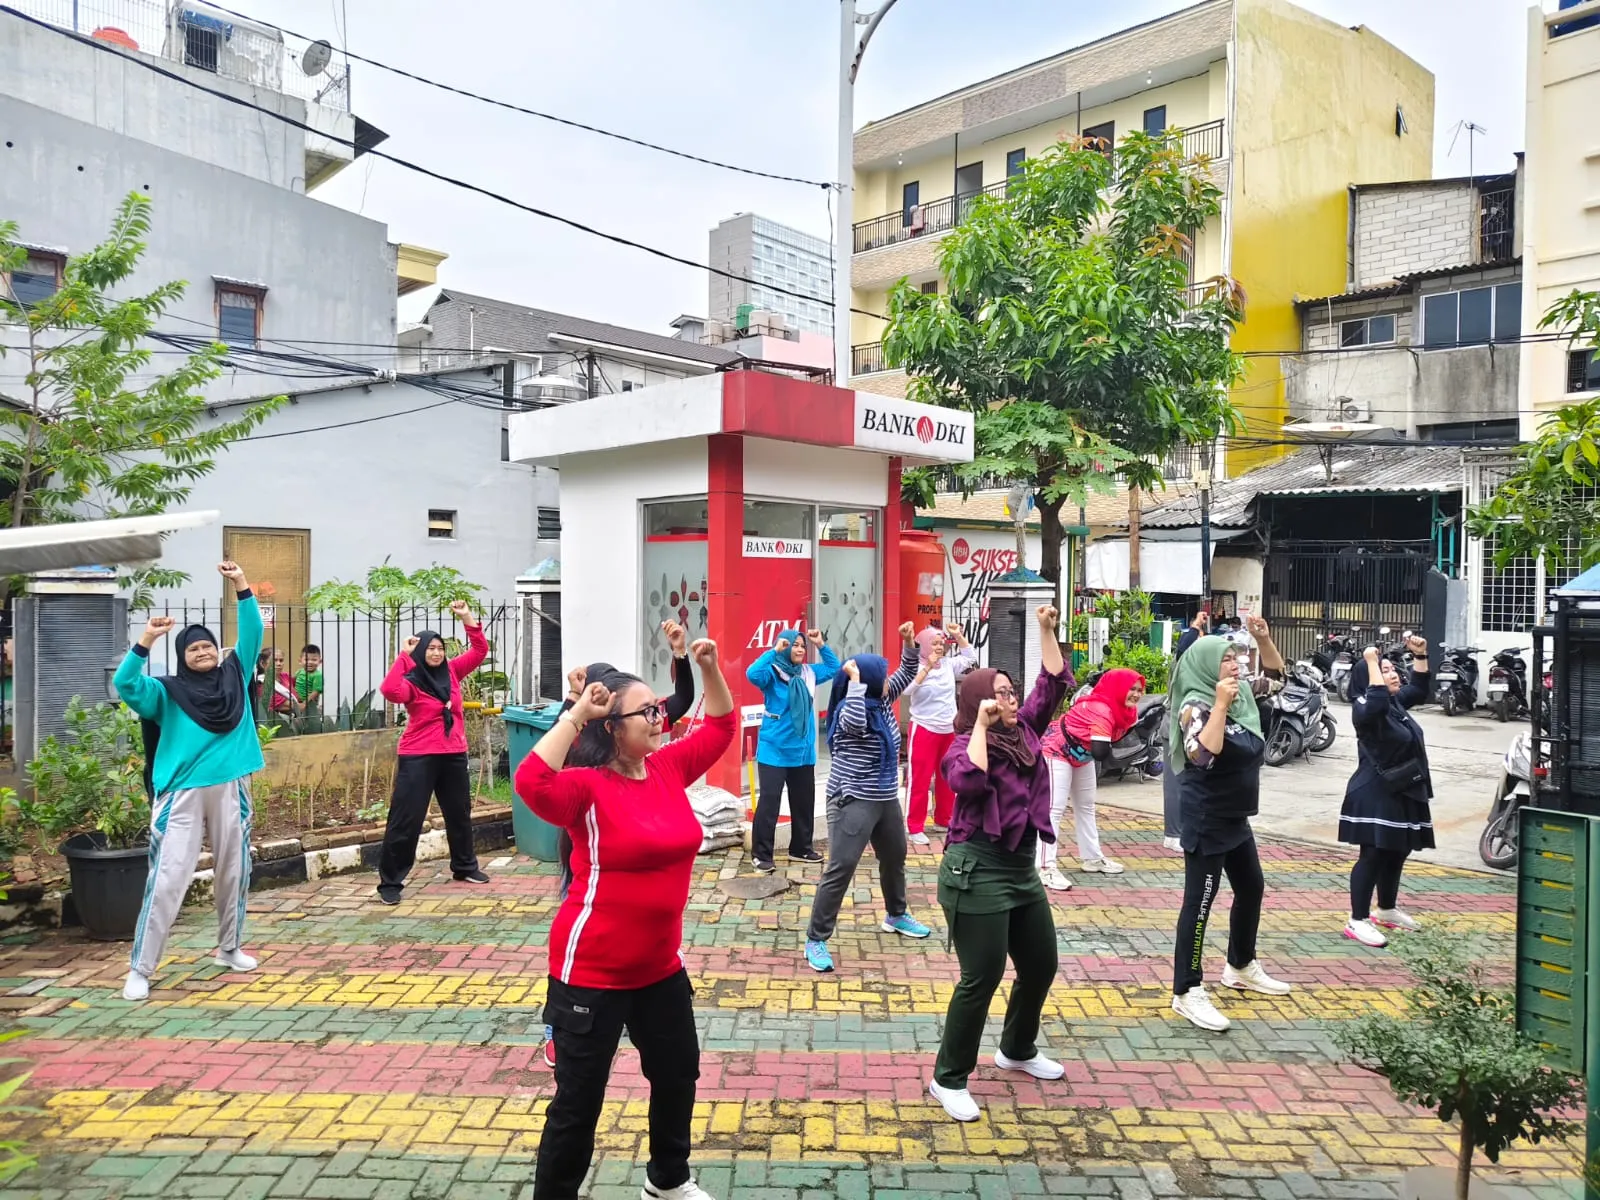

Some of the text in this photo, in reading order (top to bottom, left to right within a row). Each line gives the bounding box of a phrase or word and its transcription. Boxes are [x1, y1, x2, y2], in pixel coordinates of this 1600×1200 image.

[862, 408, 966, 445] BANK DKI
[745, 541, 803, 554] BANK DKI
[970, 548, 1018, 573] SUKSE
[1191, 873, 1214, 971] HERBALIFE NUTRITION
